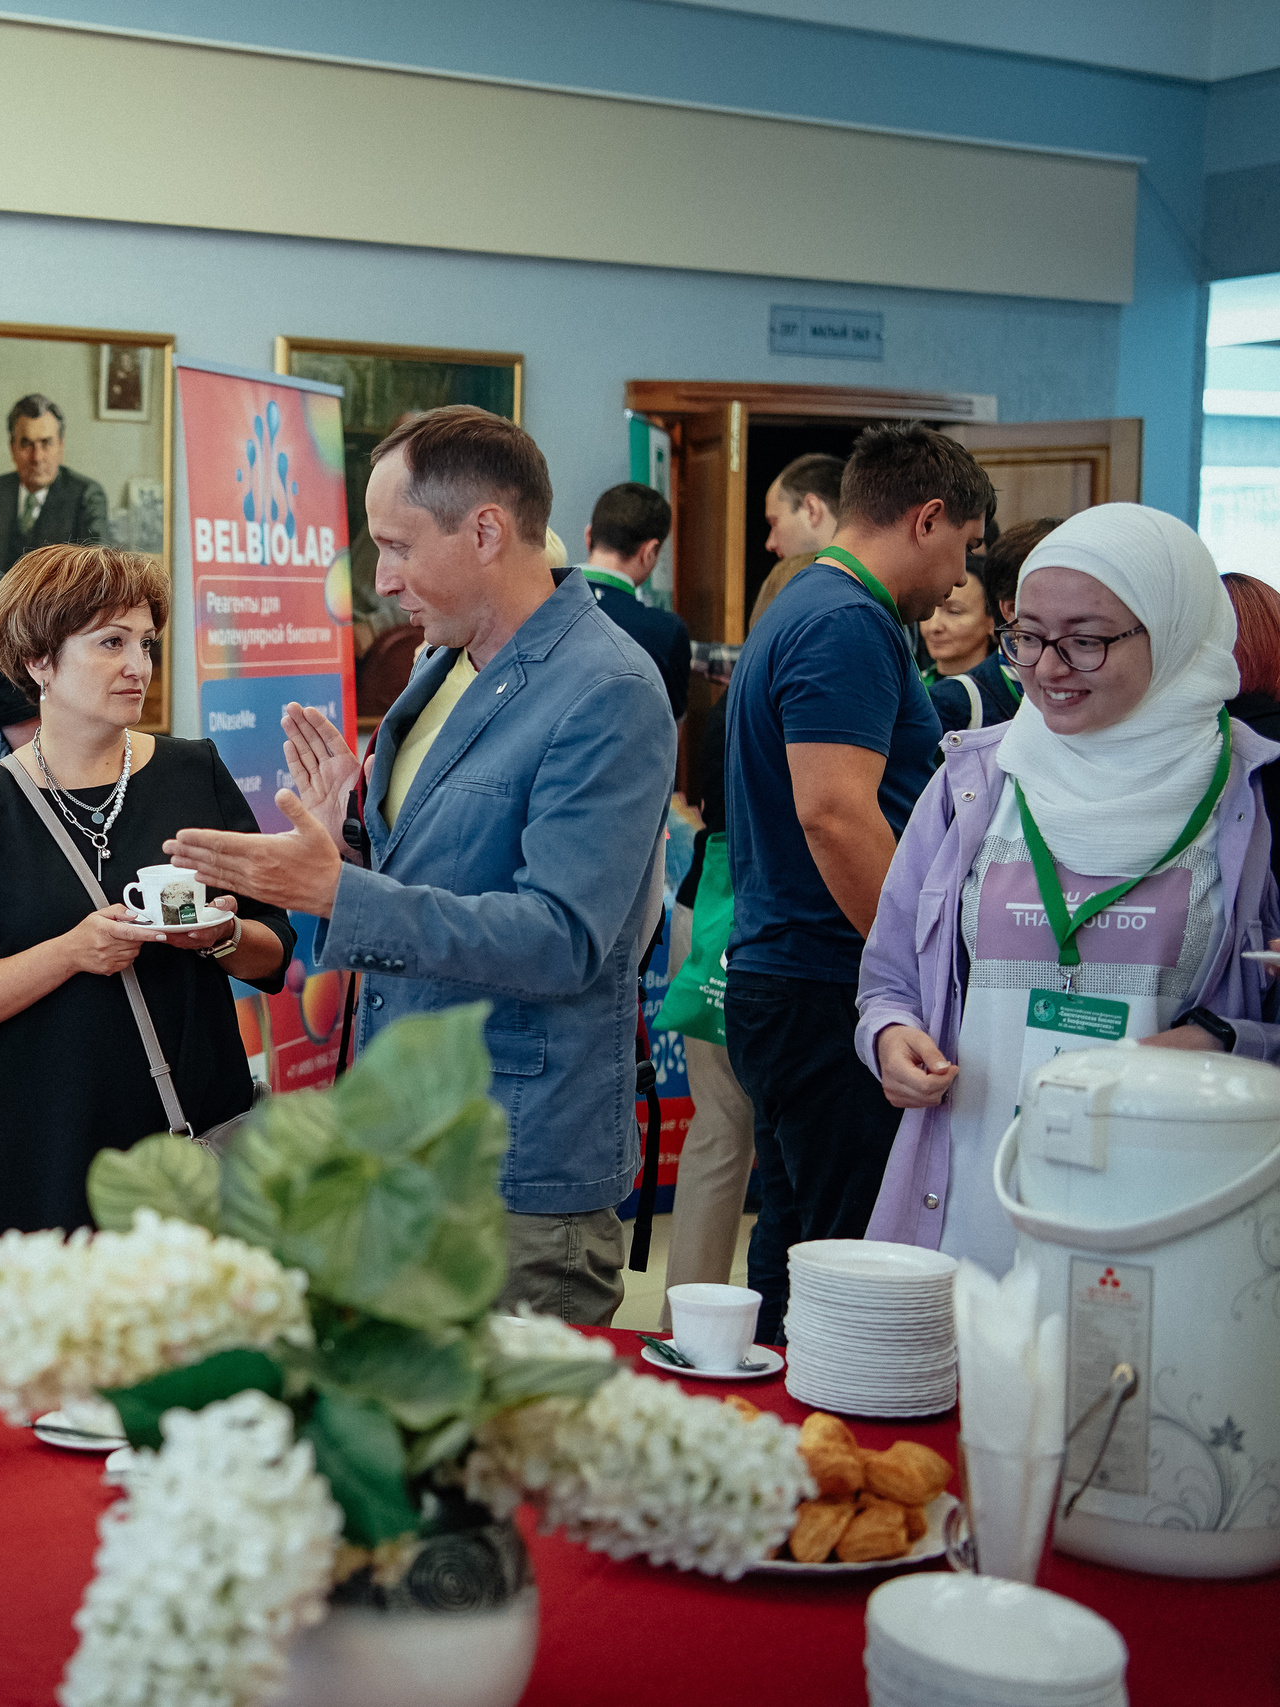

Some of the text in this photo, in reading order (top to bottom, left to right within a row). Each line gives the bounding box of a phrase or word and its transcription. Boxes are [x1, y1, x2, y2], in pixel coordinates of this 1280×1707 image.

[195, 518, 336, 567] BELBIOLAB
[1012, 911, 1147, 930] THA OU DO
